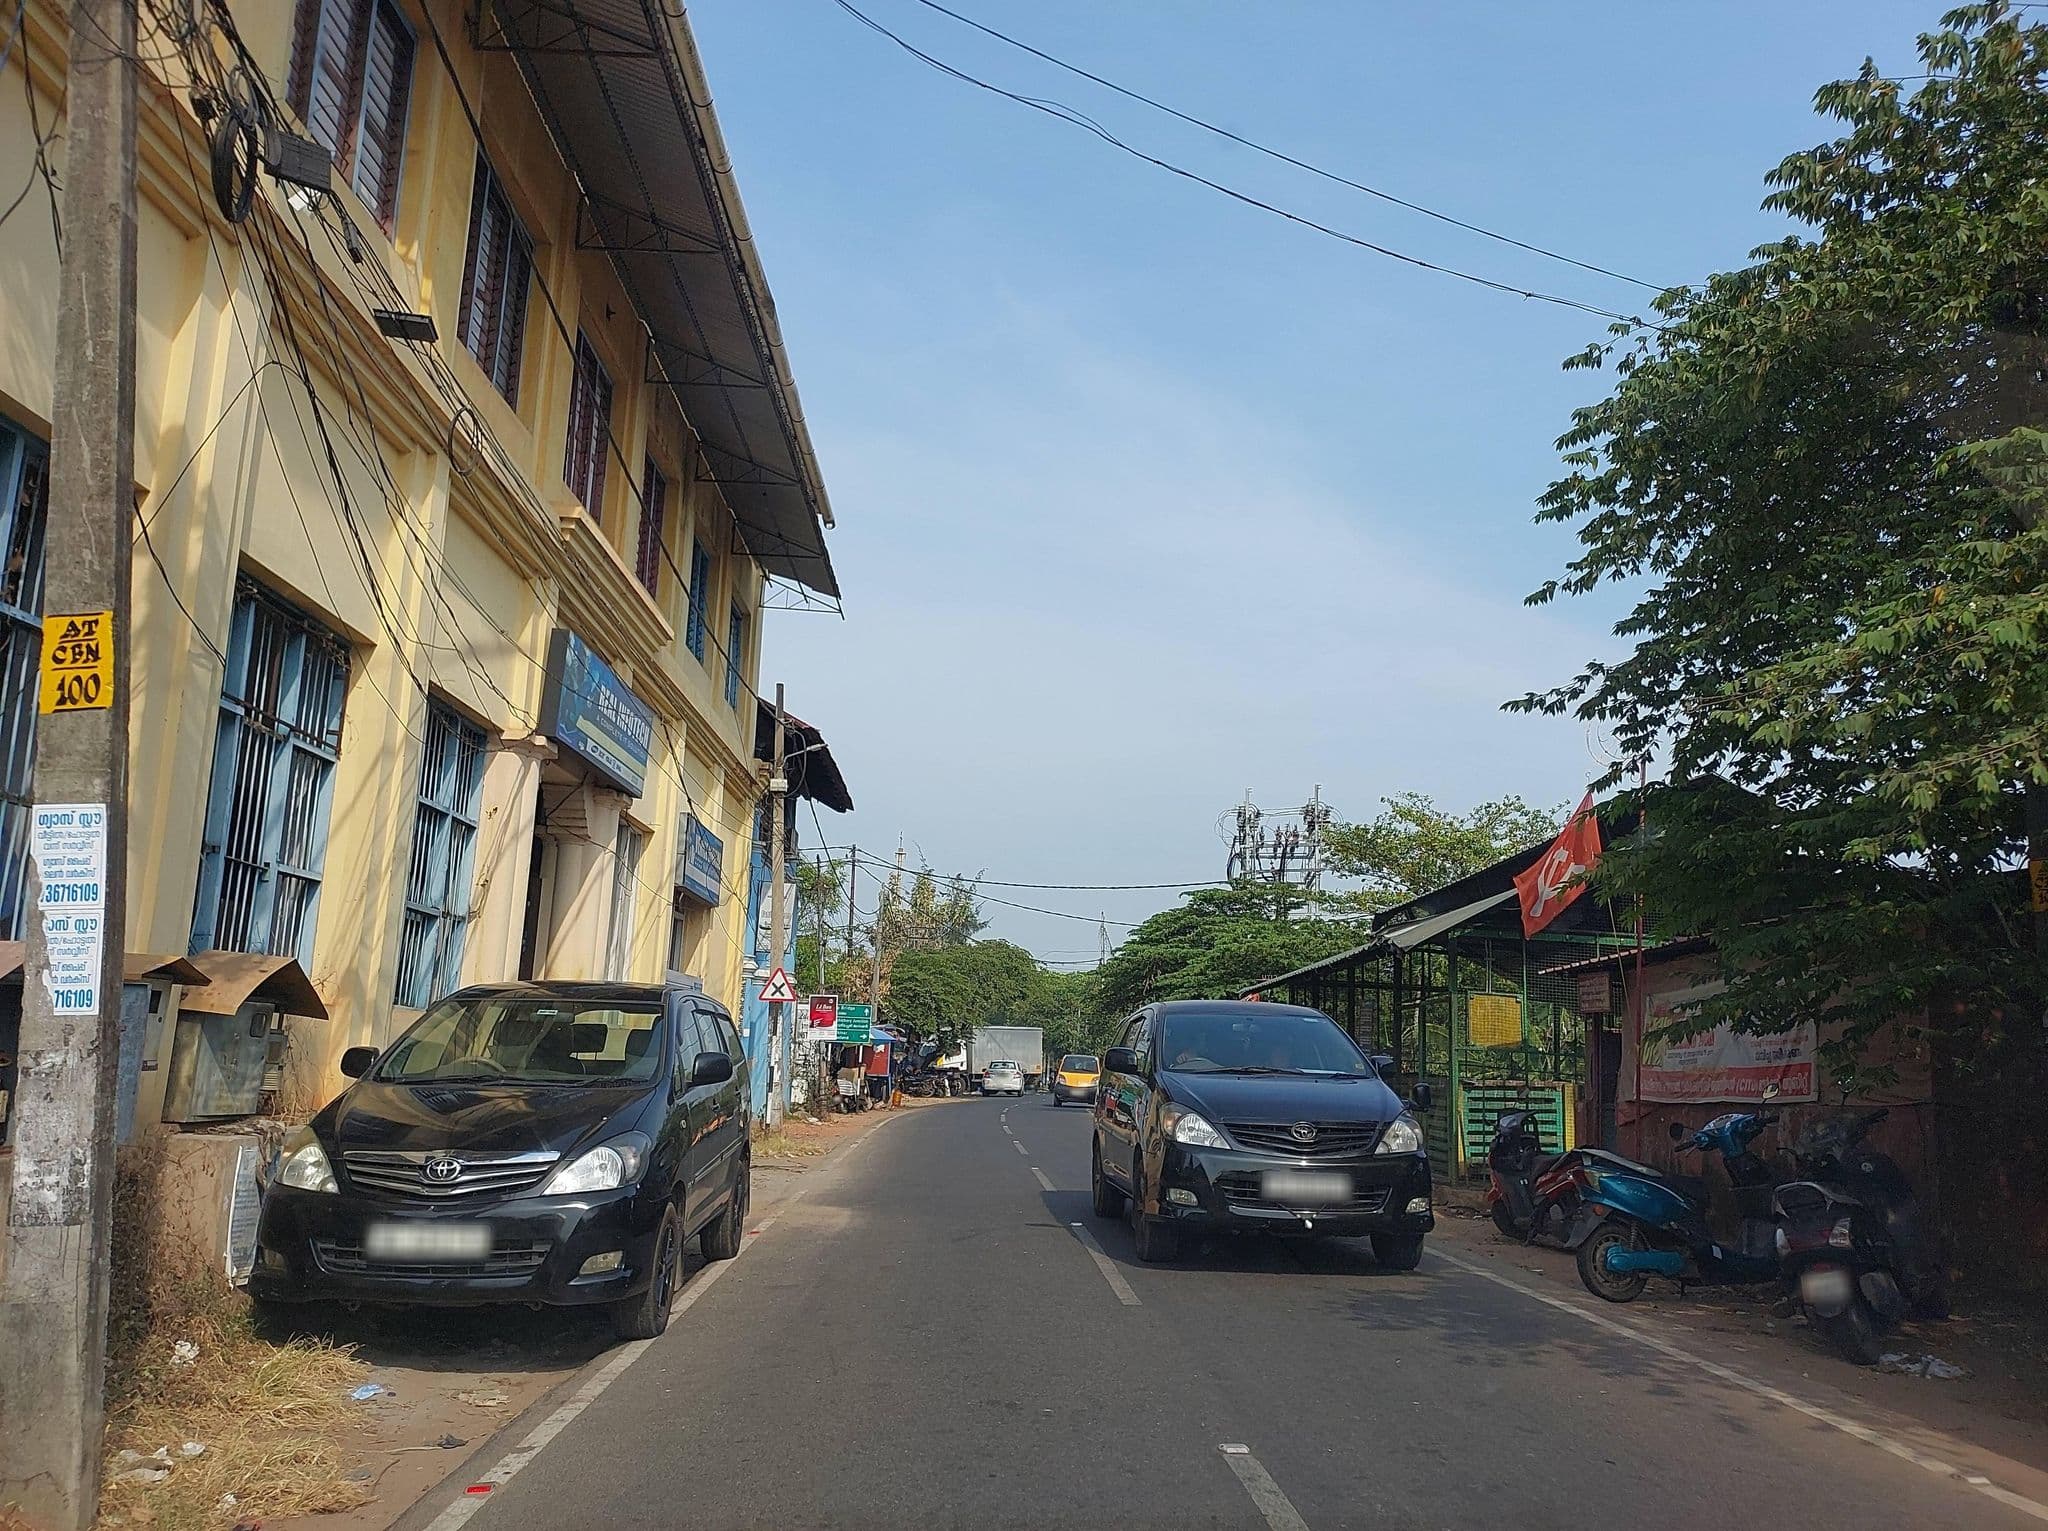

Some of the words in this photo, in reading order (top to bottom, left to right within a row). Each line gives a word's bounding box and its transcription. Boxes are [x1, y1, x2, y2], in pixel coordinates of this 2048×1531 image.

[59, 618, 99, 639] AT
[55, 672, 101, 706] 100
[598, 684, 618, 723] REAL
[617, 700, 650, 750] INFOTECH
[38, 810, 77, 829] ഗ്യാസ്
[41, 883, 99, 903] 36716109
